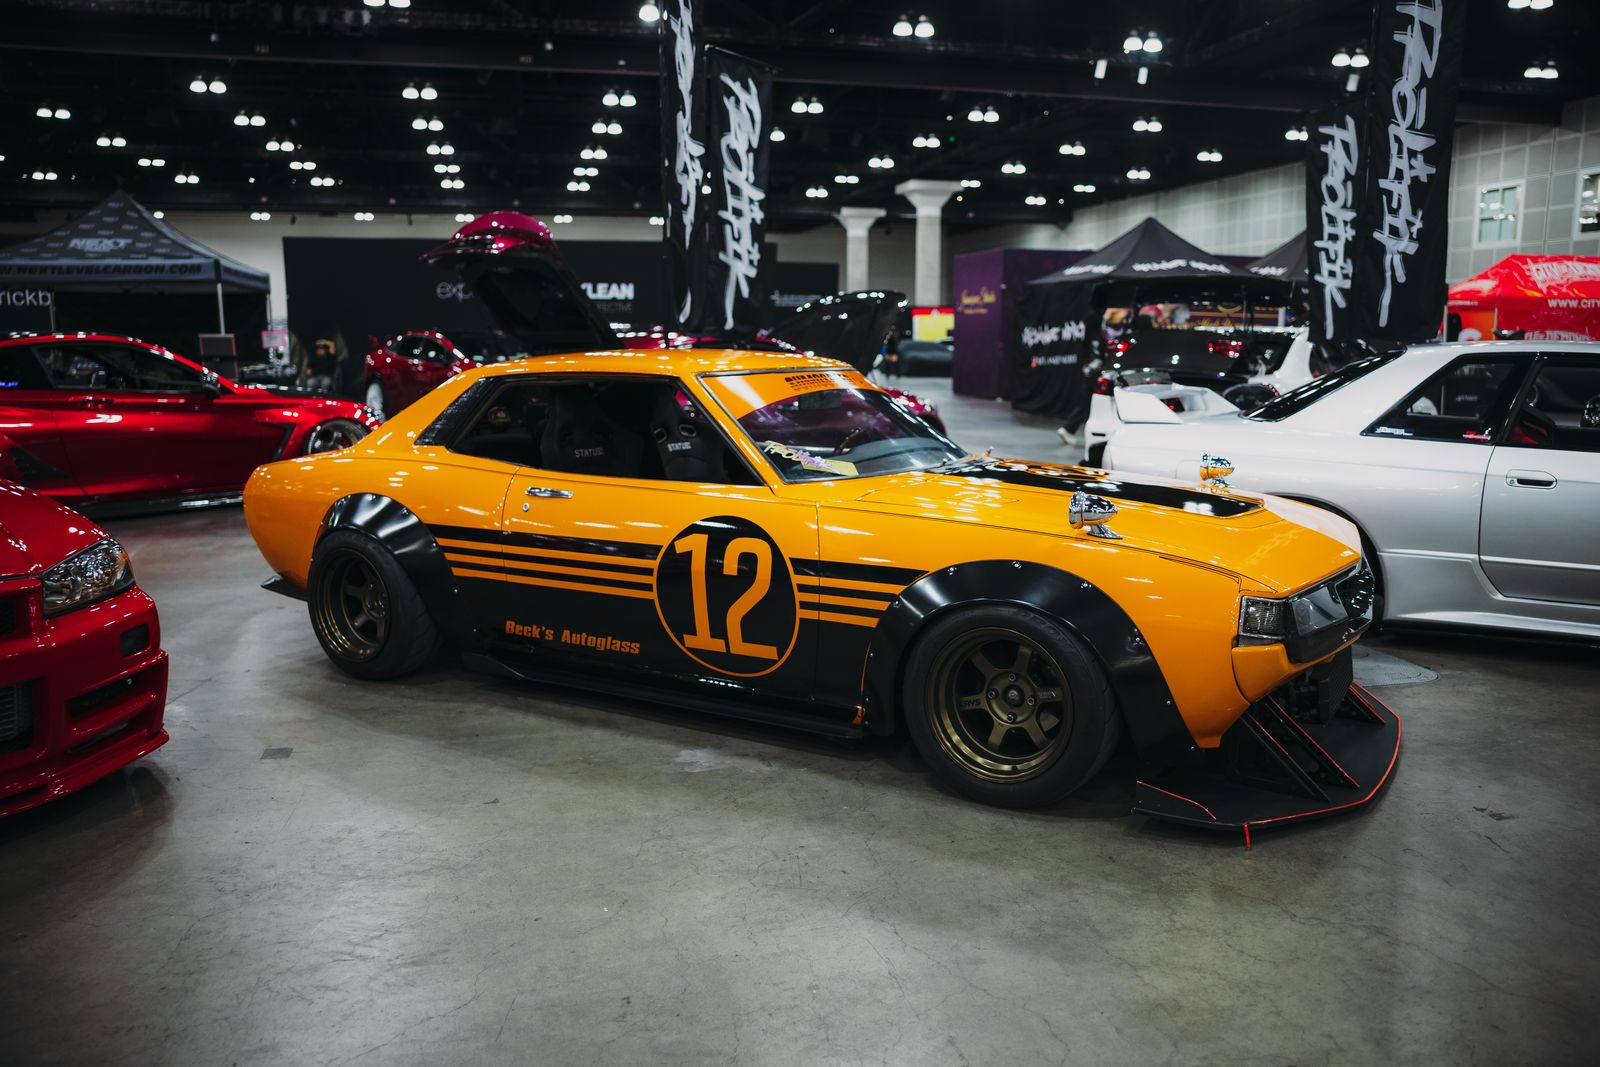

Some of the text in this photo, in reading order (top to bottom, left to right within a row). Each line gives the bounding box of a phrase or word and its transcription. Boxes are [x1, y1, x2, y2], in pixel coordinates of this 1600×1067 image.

[505, 619, 641, 654] Beck's Autoglass
[674, 533, 779, 660] 12
